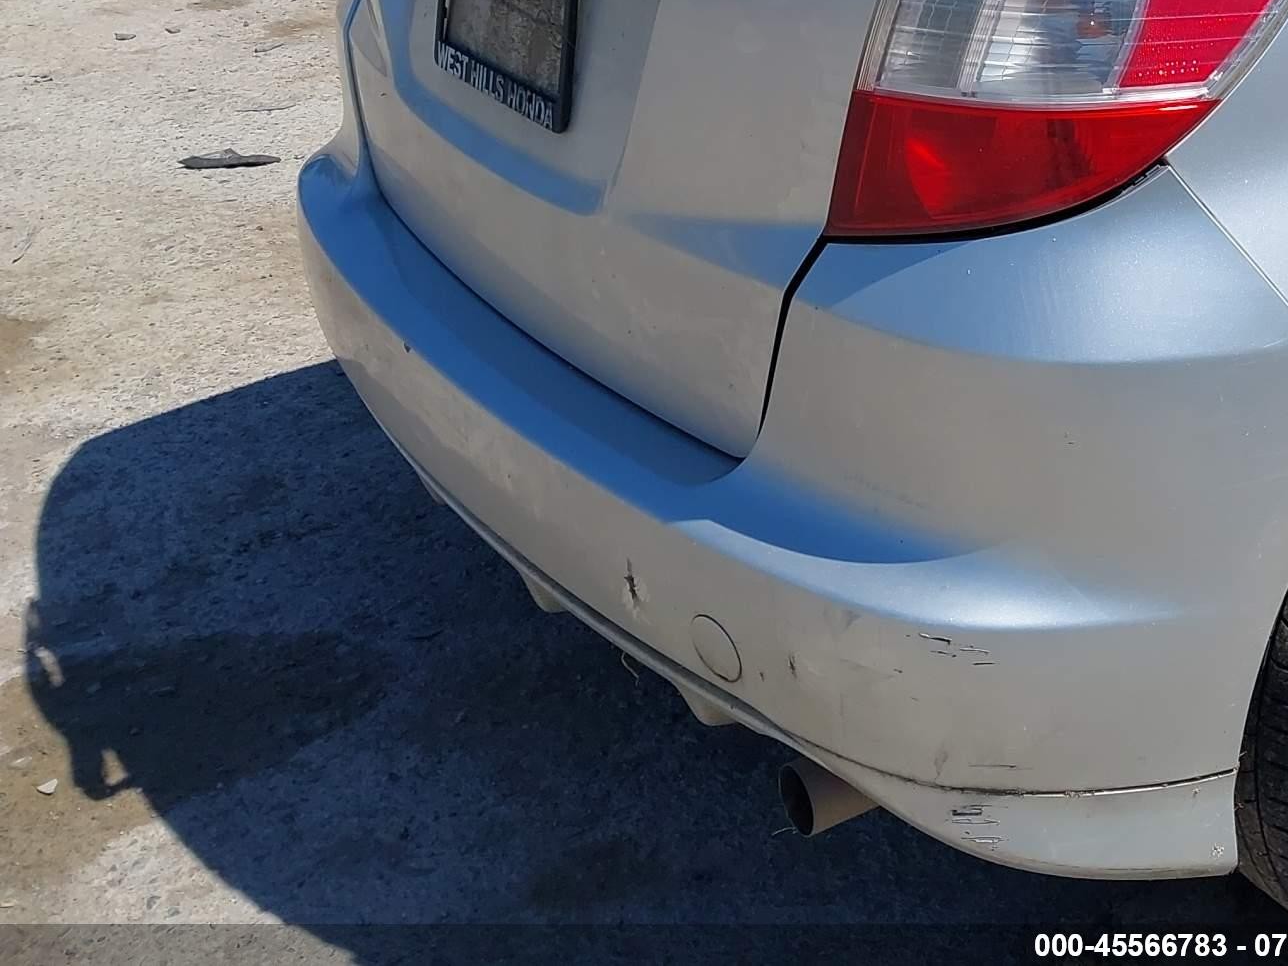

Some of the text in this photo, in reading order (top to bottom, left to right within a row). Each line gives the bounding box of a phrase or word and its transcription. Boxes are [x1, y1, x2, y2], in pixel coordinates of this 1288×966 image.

[437, 40, 554, 129] WEST HILLS HONDA
